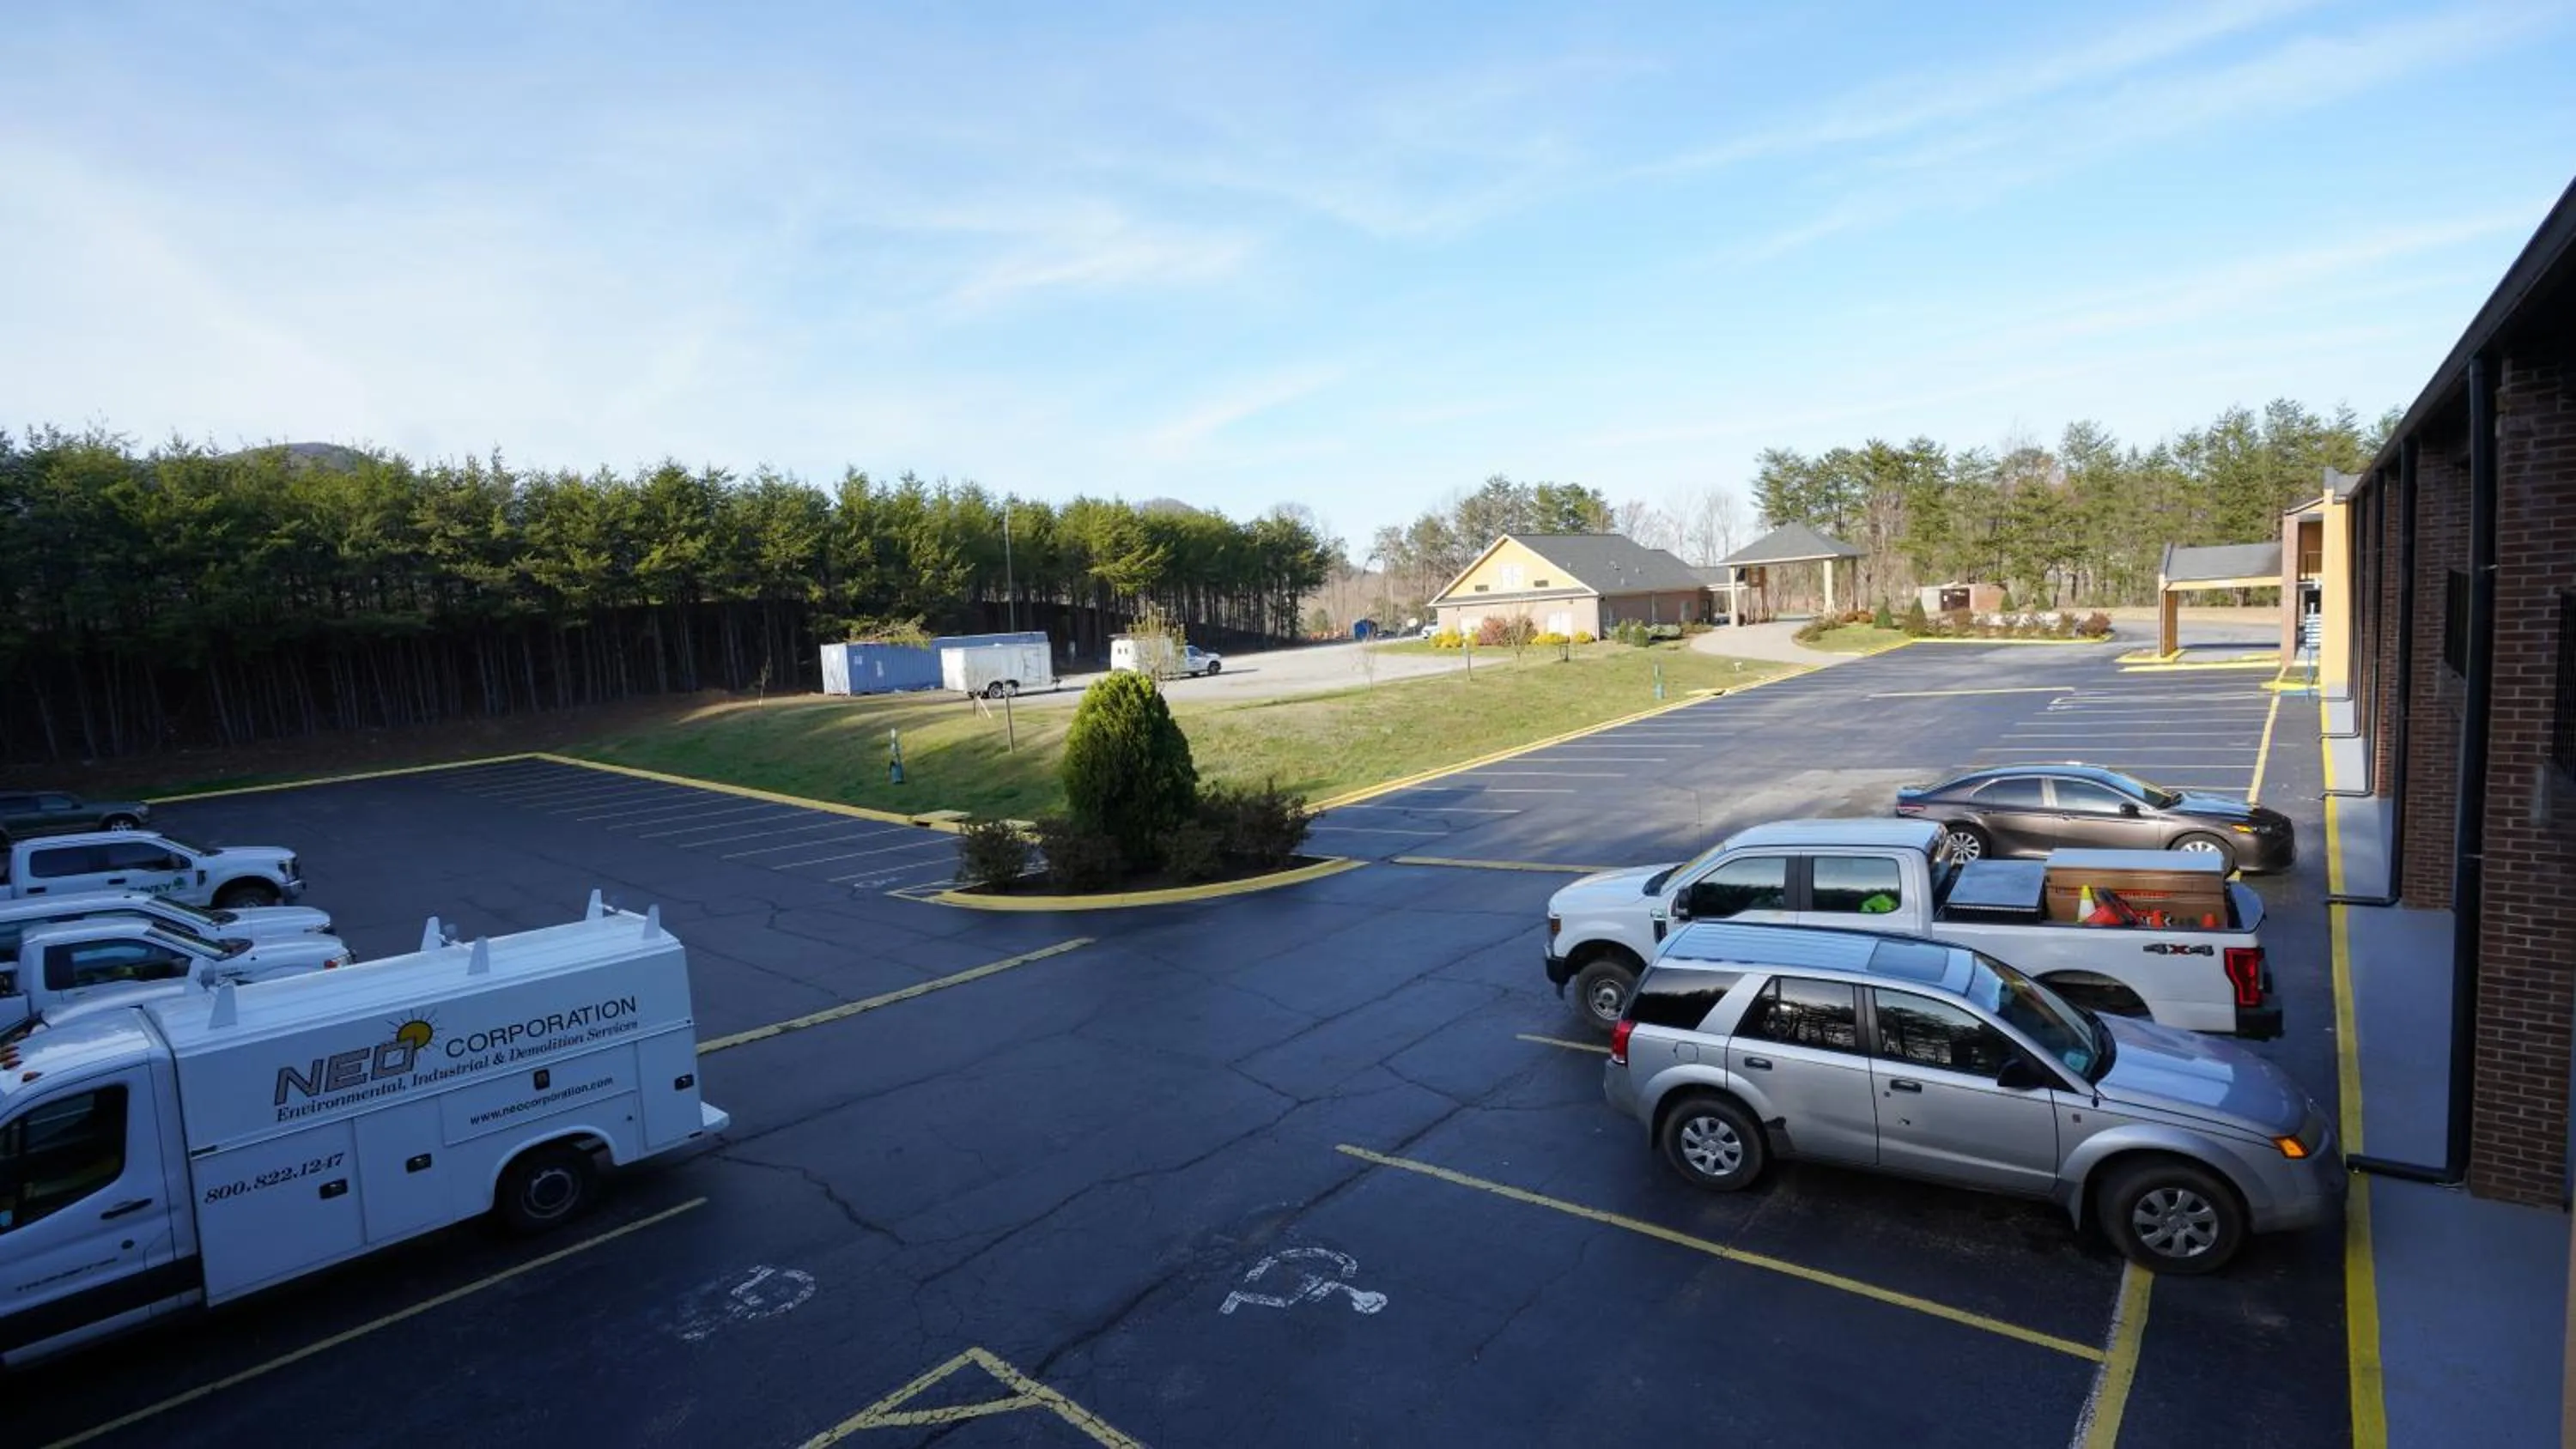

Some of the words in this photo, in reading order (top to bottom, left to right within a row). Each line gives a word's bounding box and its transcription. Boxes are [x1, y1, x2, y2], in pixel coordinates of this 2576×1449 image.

[274, 1037, 421, 1106] NEO
[446, 996, 637, 1058] CORPORATION
[277, 1077, 407, 1122] Environmental,
[412, 1058, 489, 1086] Industrial
[493, 1052, 505, 1065] &
[509, 1034, 584, 1061] Demolition
[586, 1021, 638, 1041] Services
[470, 1076, 613, 1125] www.neocorporation.com
[204, 1153, 344, 1203] 800.822.1247
